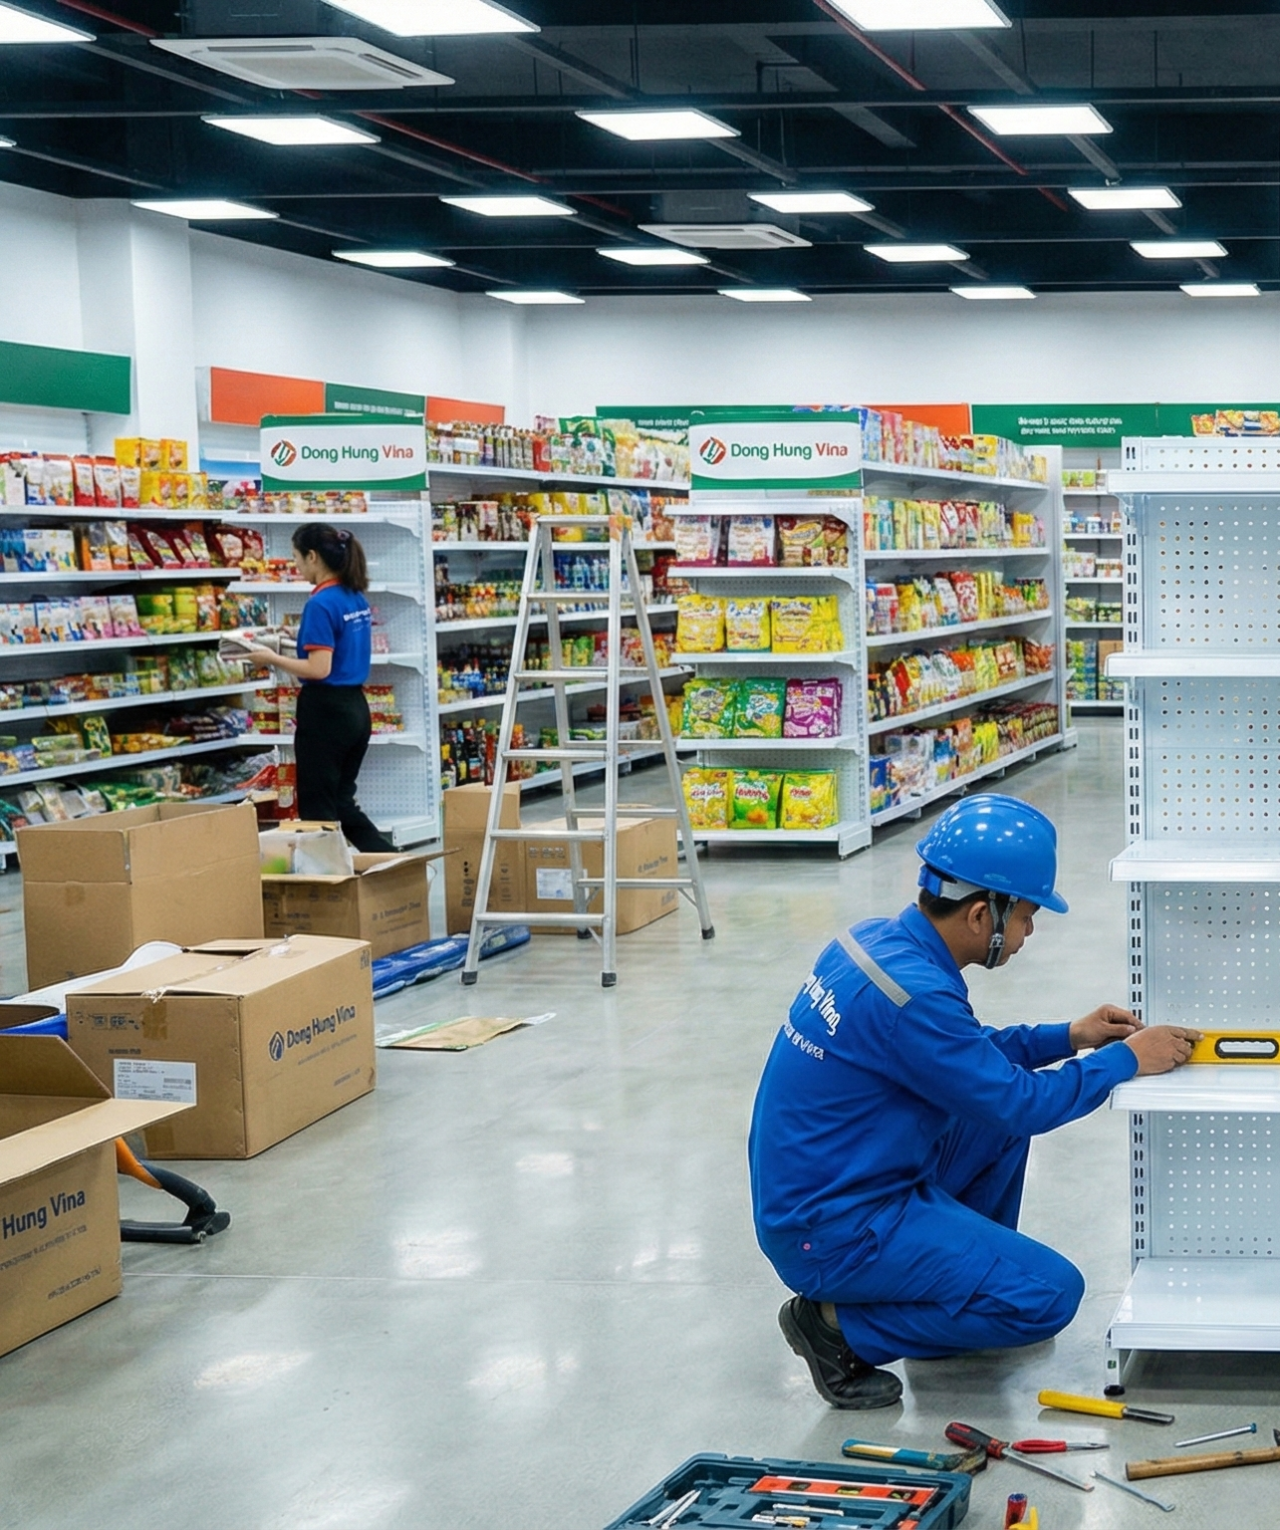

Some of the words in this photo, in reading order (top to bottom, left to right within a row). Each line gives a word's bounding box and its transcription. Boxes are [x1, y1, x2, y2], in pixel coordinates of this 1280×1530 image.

[301, 445, 339, 463] Dong
[342, 445, 379, 463] Hung
[382, 445, 414, 459] Vina
[730, 443, 769, 460] Dong
[773, 442, 812, 460] Hung
[815, 442, 848, 457] Vina
[286, 1026, 312, 1048] Dong
[312, 1014, 336, 1036] Hung
[2, 1206, 47, 1240] Hung
[50, 1190, 86, 1217] Vina
